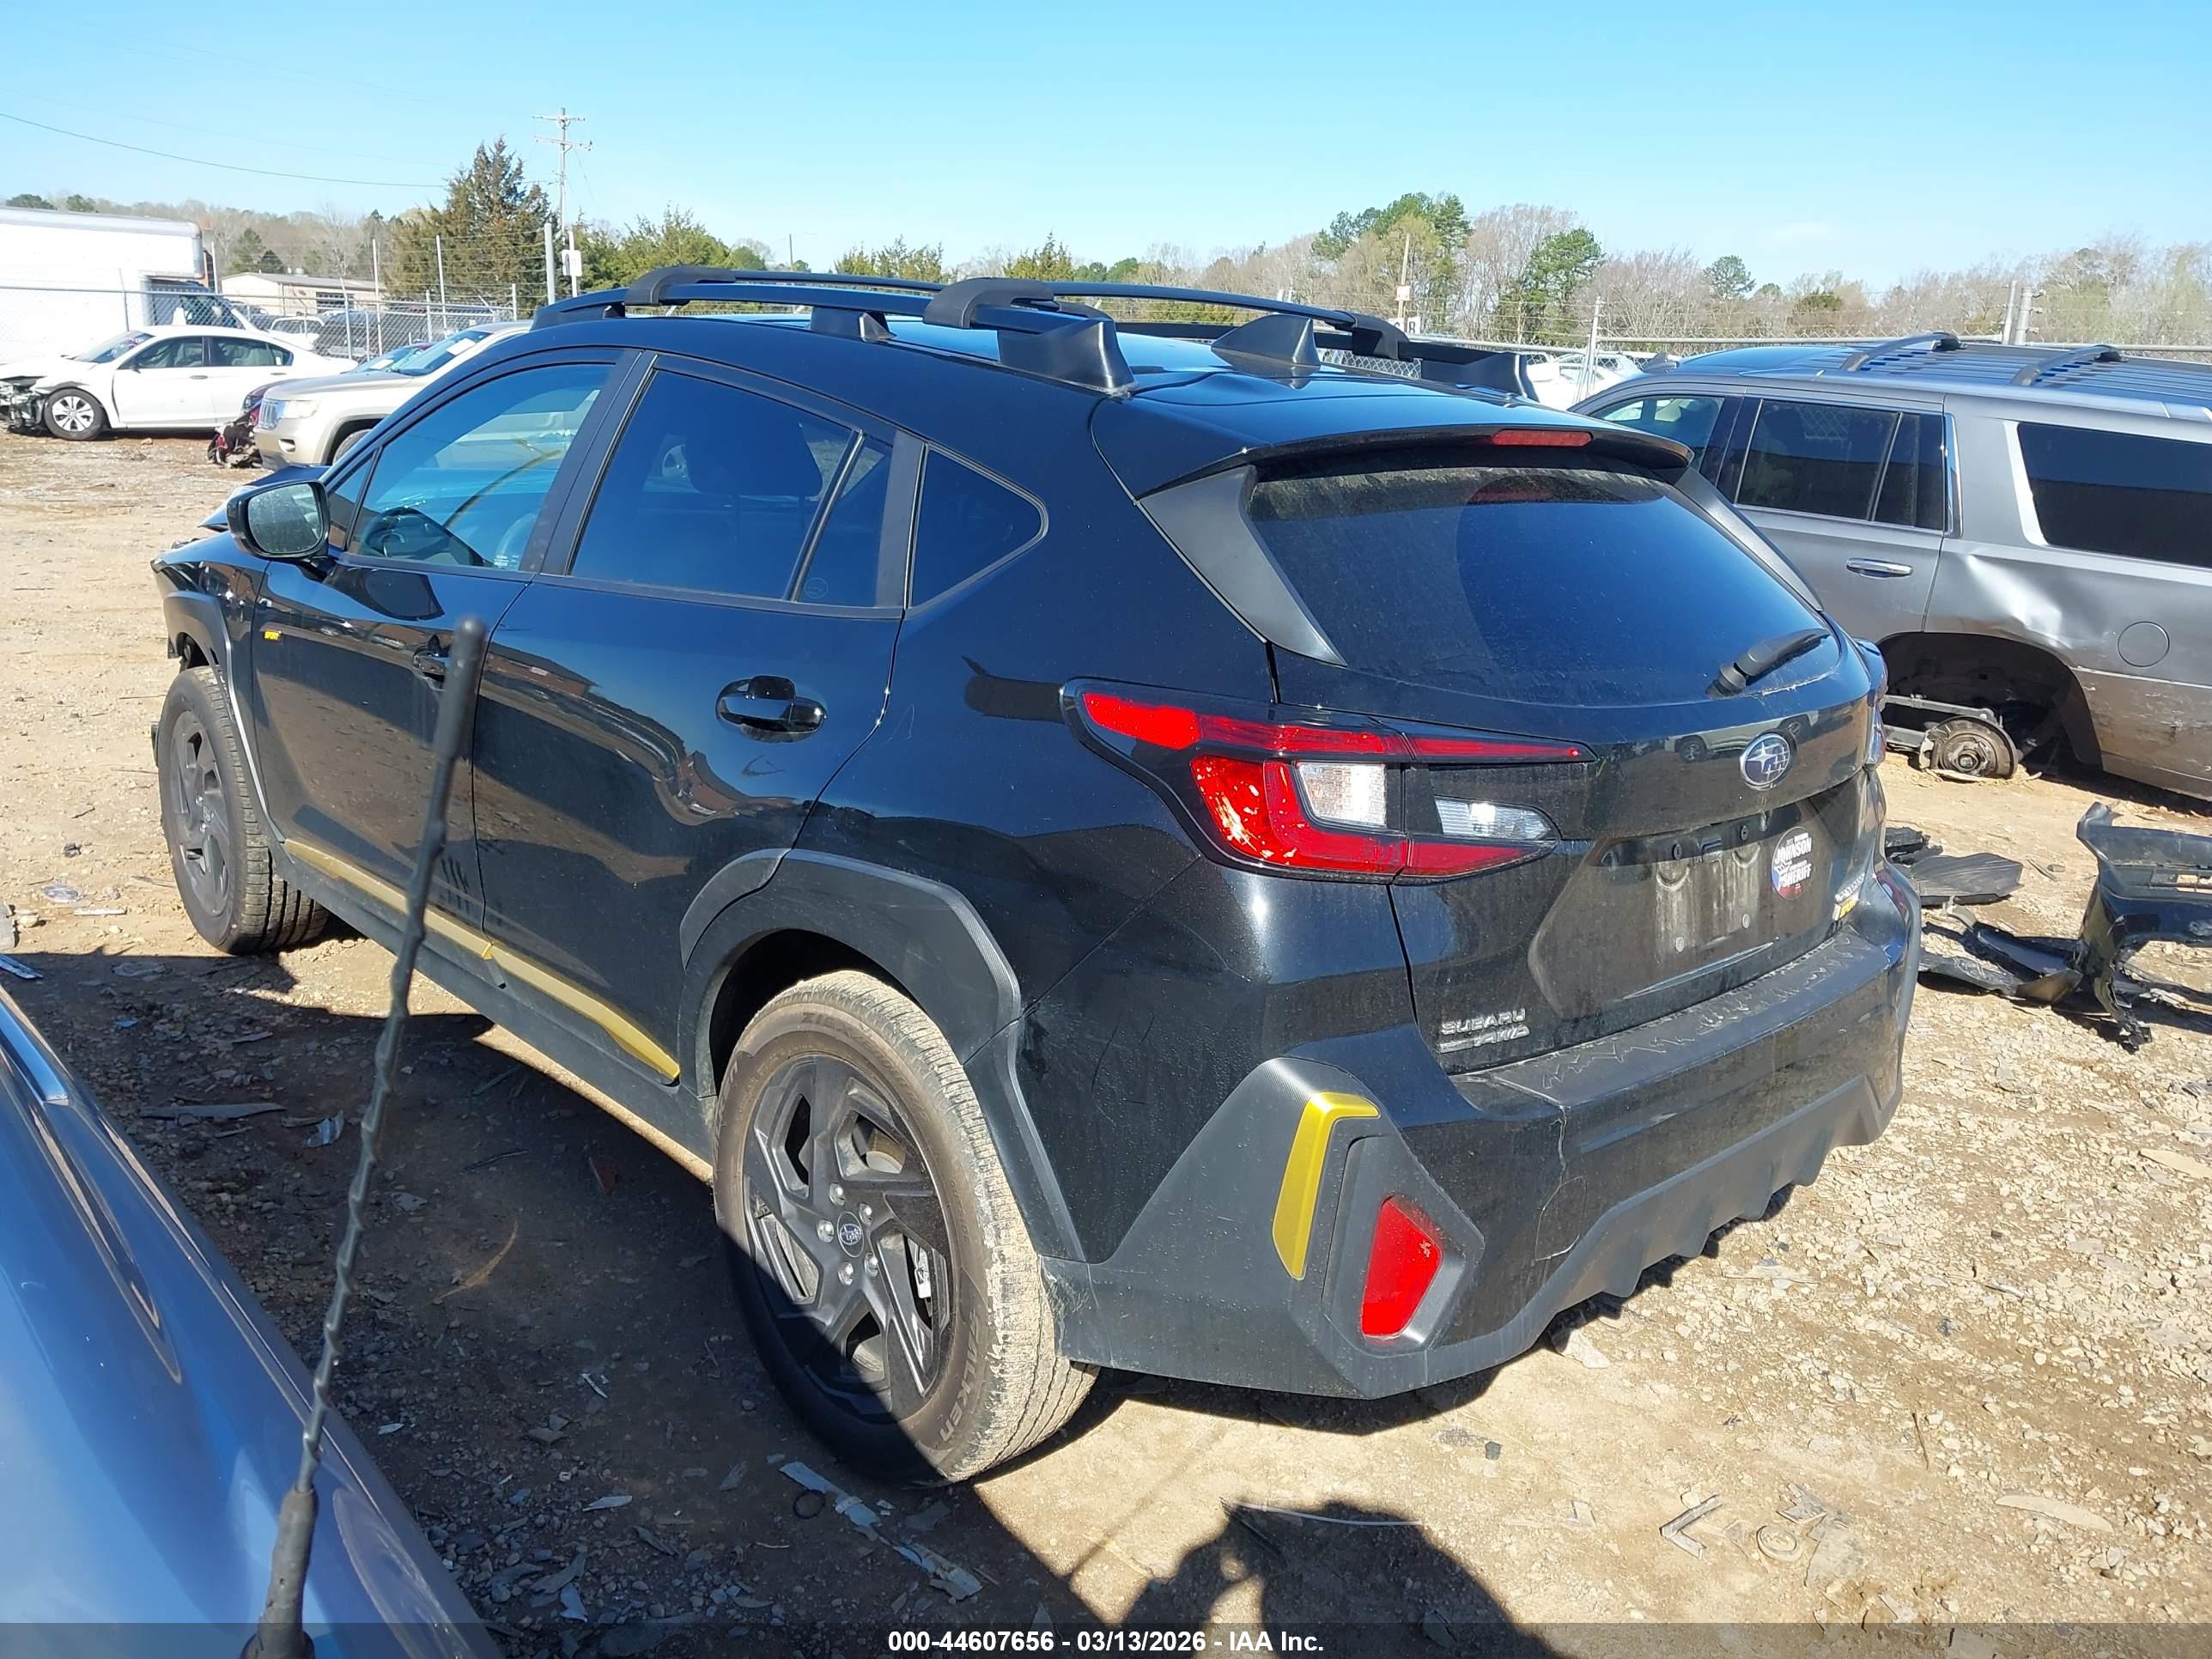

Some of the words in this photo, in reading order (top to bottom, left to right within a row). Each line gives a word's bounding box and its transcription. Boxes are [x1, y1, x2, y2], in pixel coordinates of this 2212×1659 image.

[1775, 837, 1812, 864] JOHNSON
[1780, 864, 1812, 887] SHERIFF
[1442, 1007, 1526, 1036] SUBARU
